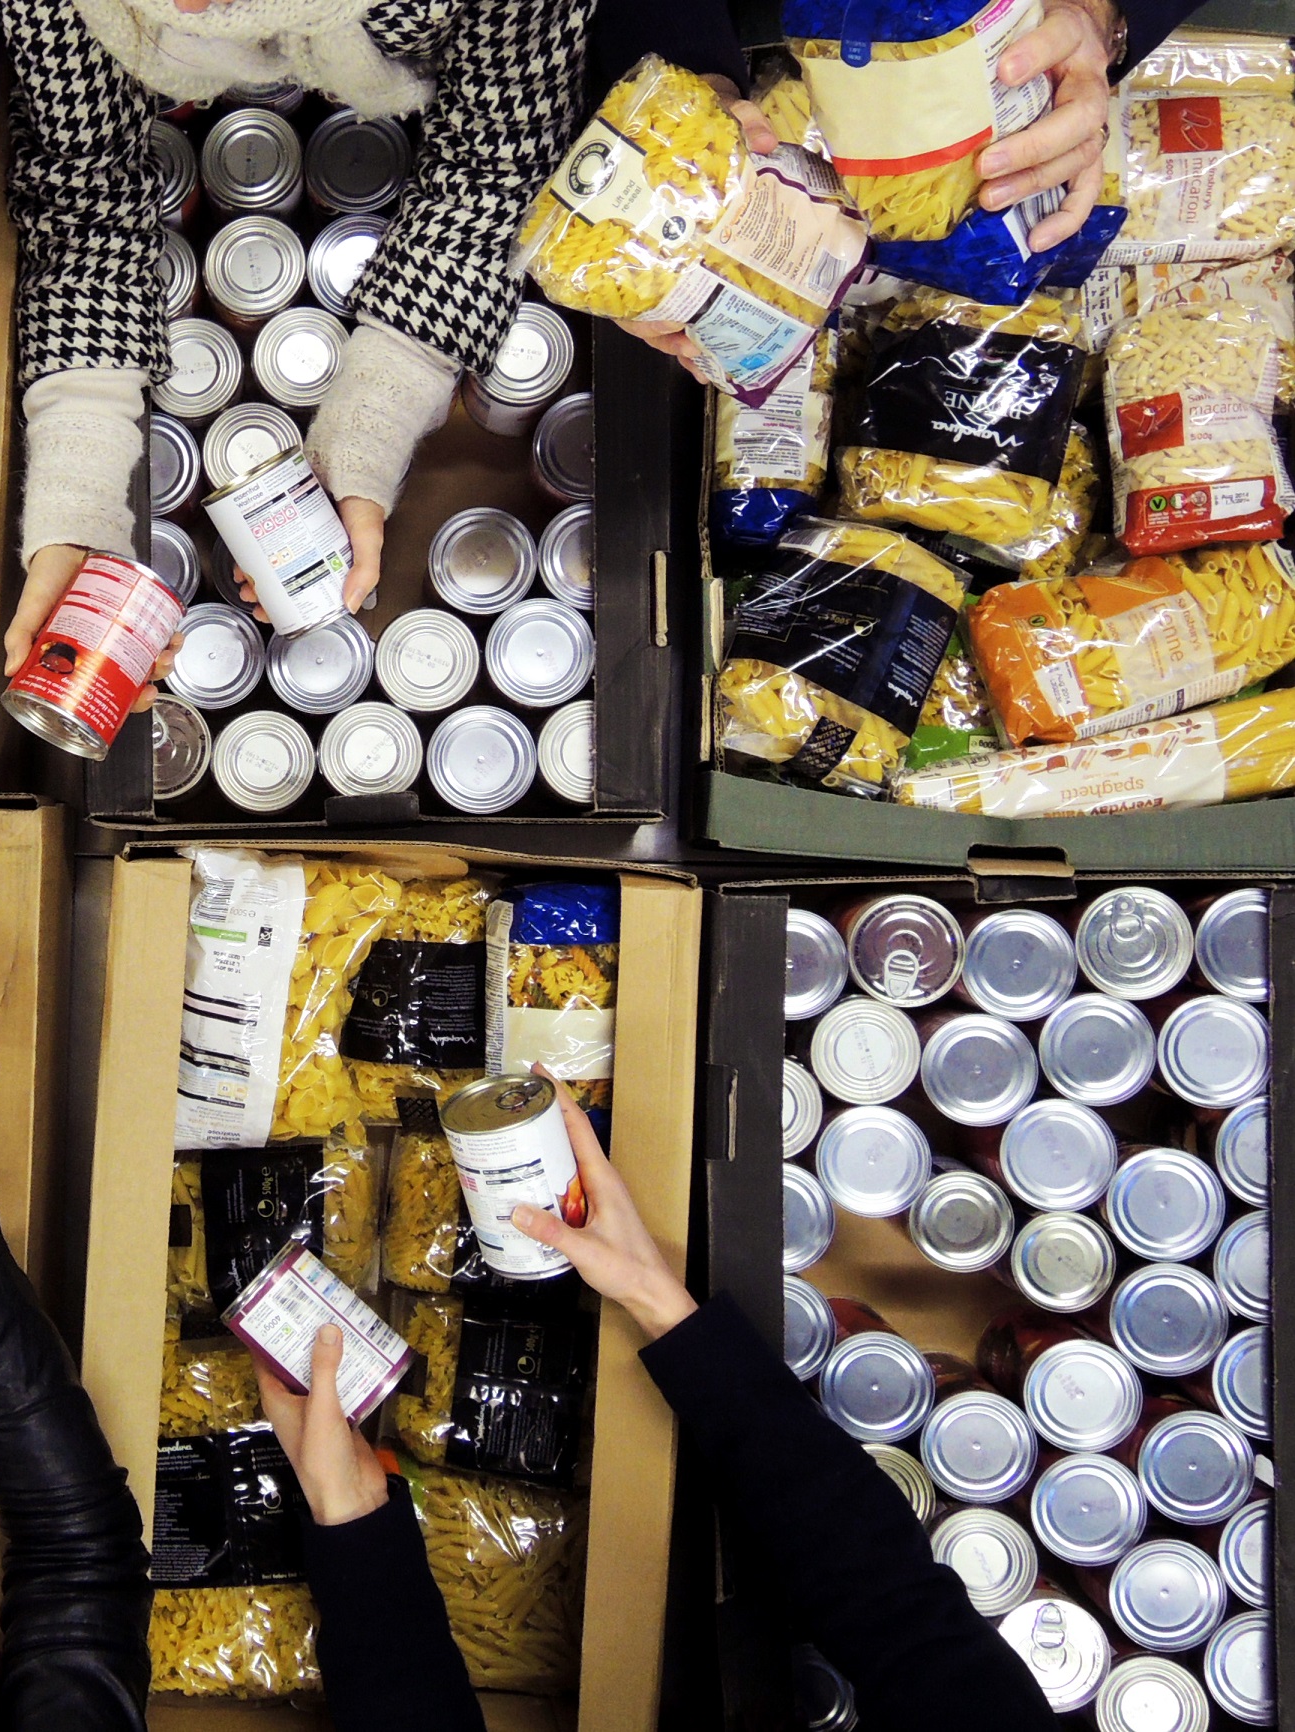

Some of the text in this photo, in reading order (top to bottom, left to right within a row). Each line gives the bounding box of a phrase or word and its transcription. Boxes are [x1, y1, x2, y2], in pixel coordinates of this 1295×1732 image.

[611, 179, 637, 209] Lift and
[1185, 157, 1204, 224] macaroni
[618, 185, 644, 214] re-seal
[931, 420, 1025, 448] Napolina
[1190, 432, 1213, 442] 500g
[233, 483, 260, 504] essential
[236, 492, 263, 509] Waitrose
[1150, 599, 1188, 665] penne
[59, 675, 77, 690] Soup
[1055, 671, 1073, 706] Aug 2014
[74, 684, 96, 701] Oxtail
[92, 697, 110, 712] Heinz
[89, 713, 101, 725] keep
[97, 712, 110, 723] blend
[815, 728, 837, 741] RESEAL
[836, 728, 852, 740] PEEL
[809, 736, 832, 750] RESEAL
[978, 738, 997, 752] 500g
[1060, 778, 1144, 802] spaghetti
[1091, 797, 1164, 816] Everyday
[229, 908, 247, 917] 500g
[429, 1033, 476, 1046] Napolina
[207, 1129, 241, 1137] Waitrose
[262, 1177, 274, 1195] 500g
[228, 1257, 243, 1294] Napolina
[262, 1311, 283, 1333] 400g
